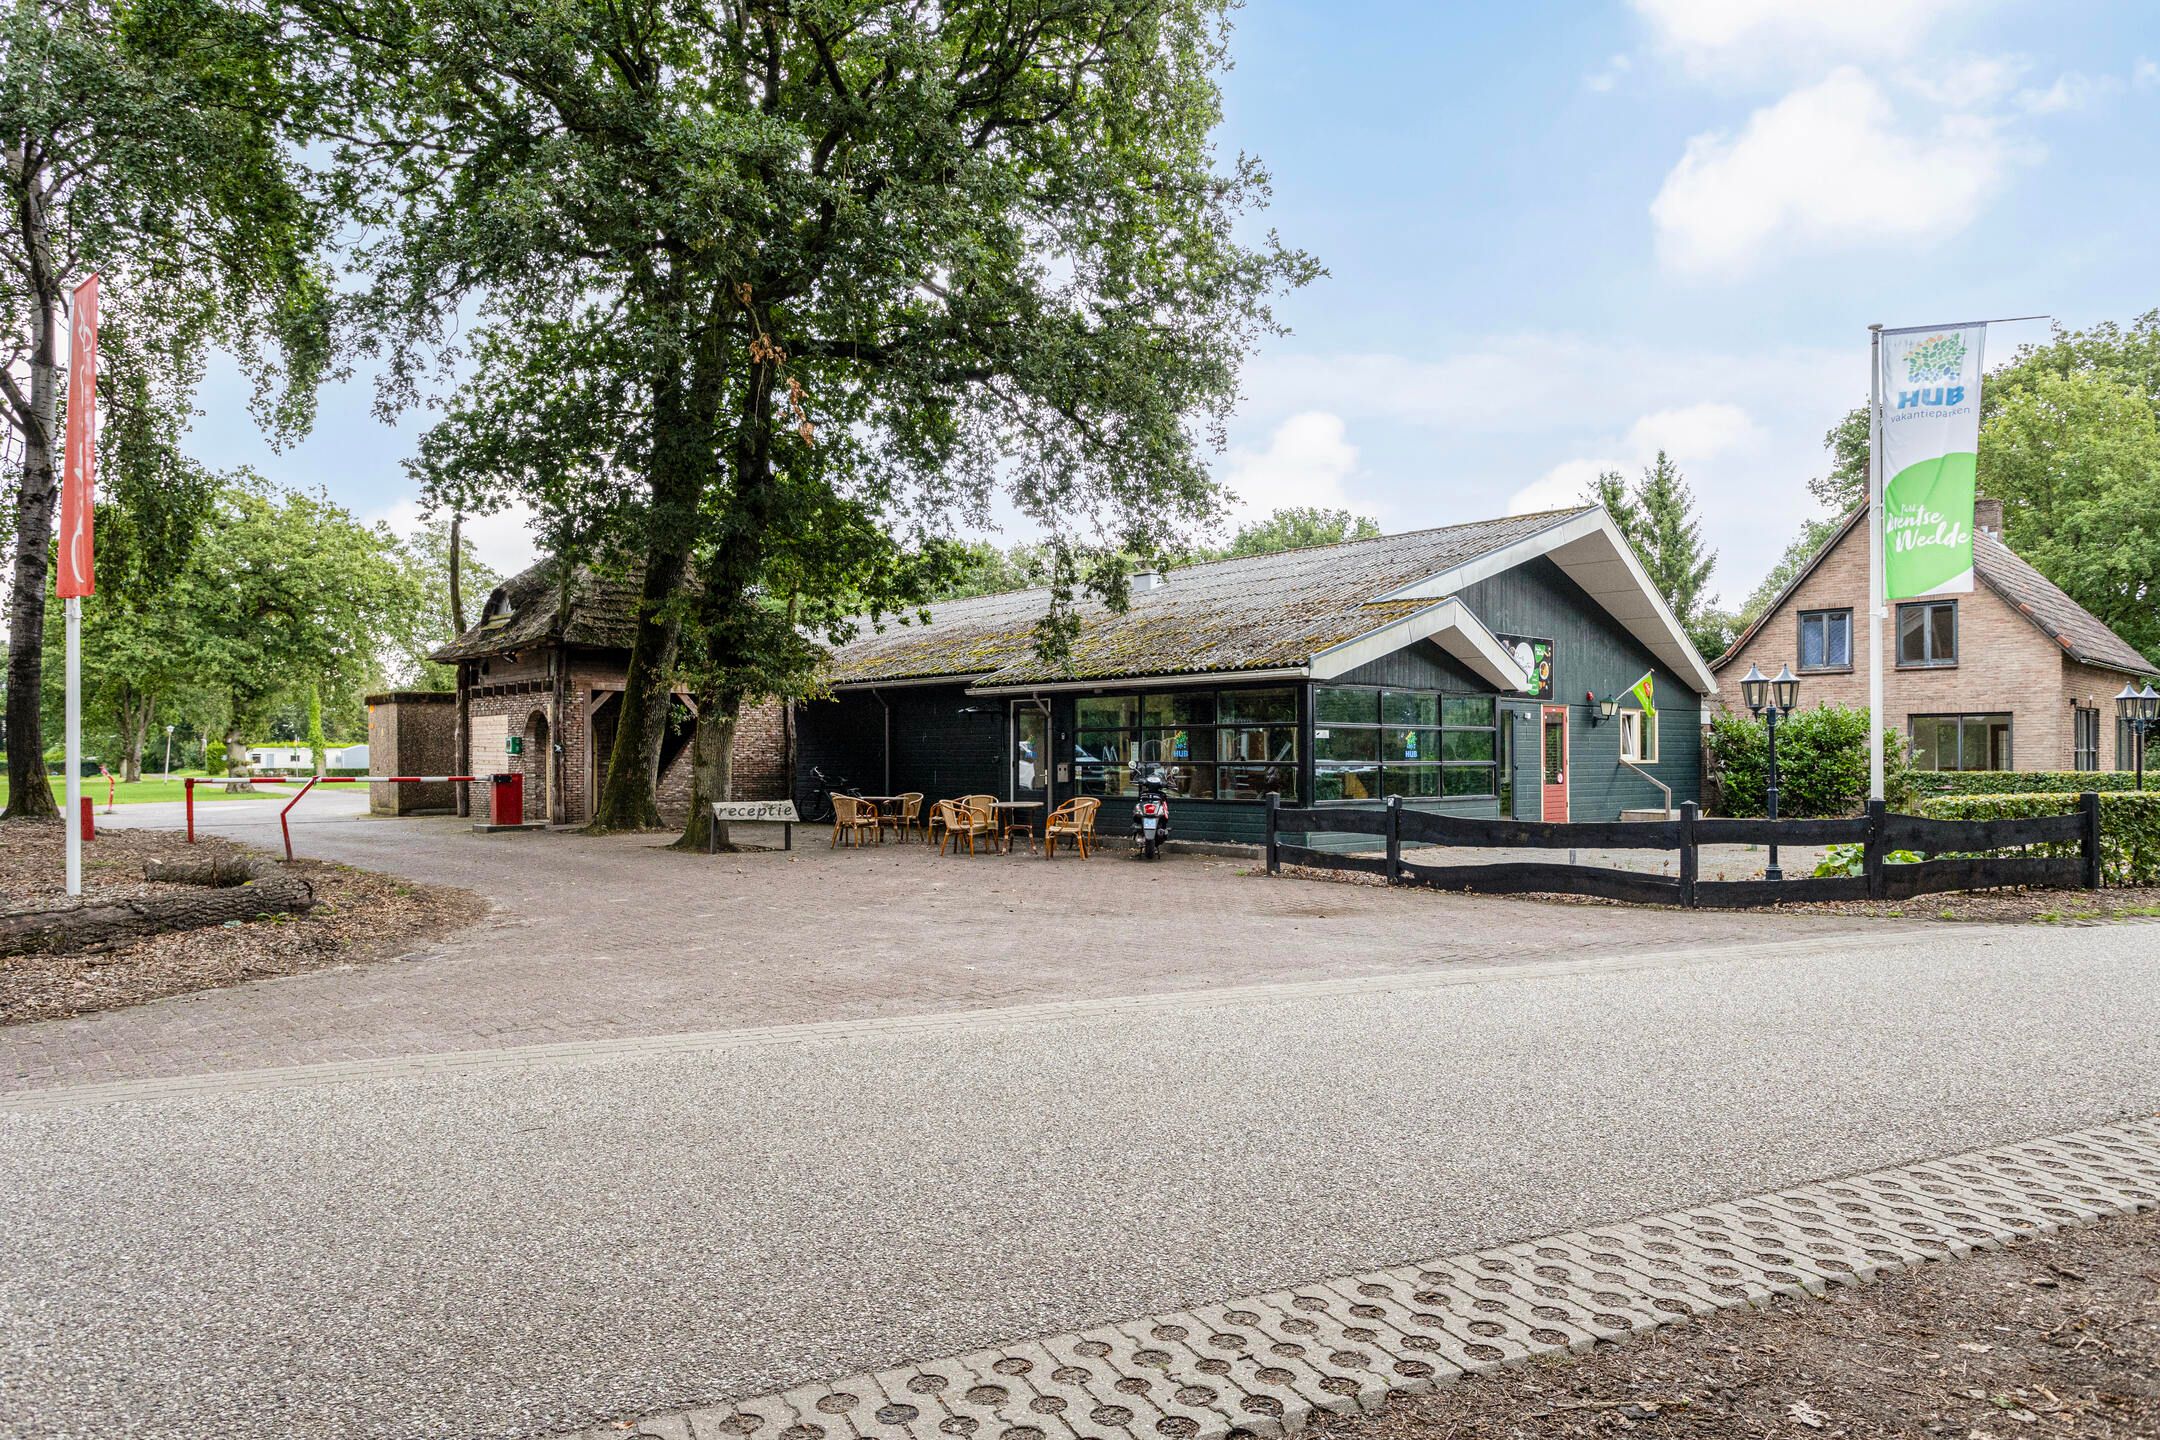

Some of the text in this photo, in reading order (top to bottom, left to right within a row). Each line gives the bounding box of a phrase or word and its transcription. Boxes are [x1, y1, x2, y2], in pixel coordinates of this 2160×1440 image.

[1897, 385, 1965, 410] HUB
[1890, 407, 1971, 423] vakantieparken
[1895, 520, 1972, 553] Weelde
[1173, 750, 1189, 758] HUB
[718, 803, 793, 820] receptie
